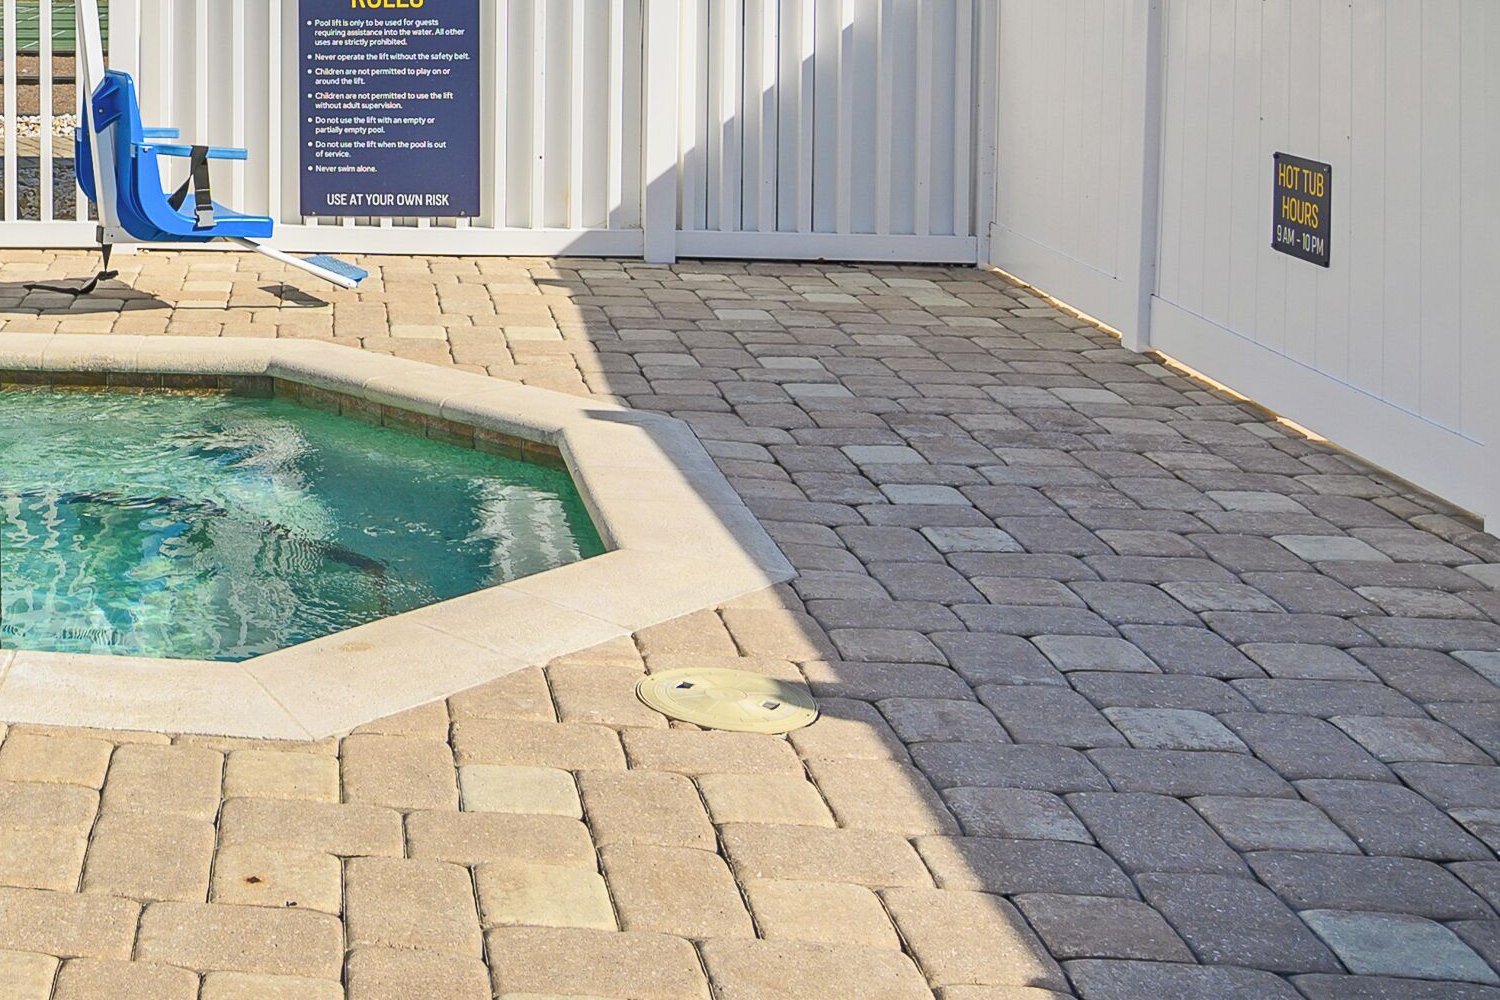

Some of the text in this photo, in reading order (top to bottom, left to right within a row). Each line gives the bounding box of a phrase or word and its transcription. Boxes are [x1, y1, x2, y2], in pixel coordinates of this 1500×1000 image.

[403, 18, 414, 26] for
[314, 29, 346, 37] requiring
[344, 39, 368, 47] strictly
[369, 38, 408, 47] prohibited.
[430, 52, 453, 61] safety
[371, 68, 406, 76] permitted
[416, 68, 431, 76] play
[371, 92, 406, 100] permitted
[361, 102, 403, 110] supervision.
[403, 117, 426, 125] empty
[315, 126, 385, 135] partially empty pool.
[366, 140, 377, 148] lift
[410, 141, 426, 149] pool
[1278, 163, 1324, 198] HOT TUB
[326, 193, 450, 206] USE AT YOUR OWN RISK
[1282, 195, 1319, 229] HOURS
[1277, 225, 1282, 242] 9
[1282, 227, 1295, 247] AM
[1302, 233, 1311, 252] 10
[1311, 235, 1324, 256] PM
